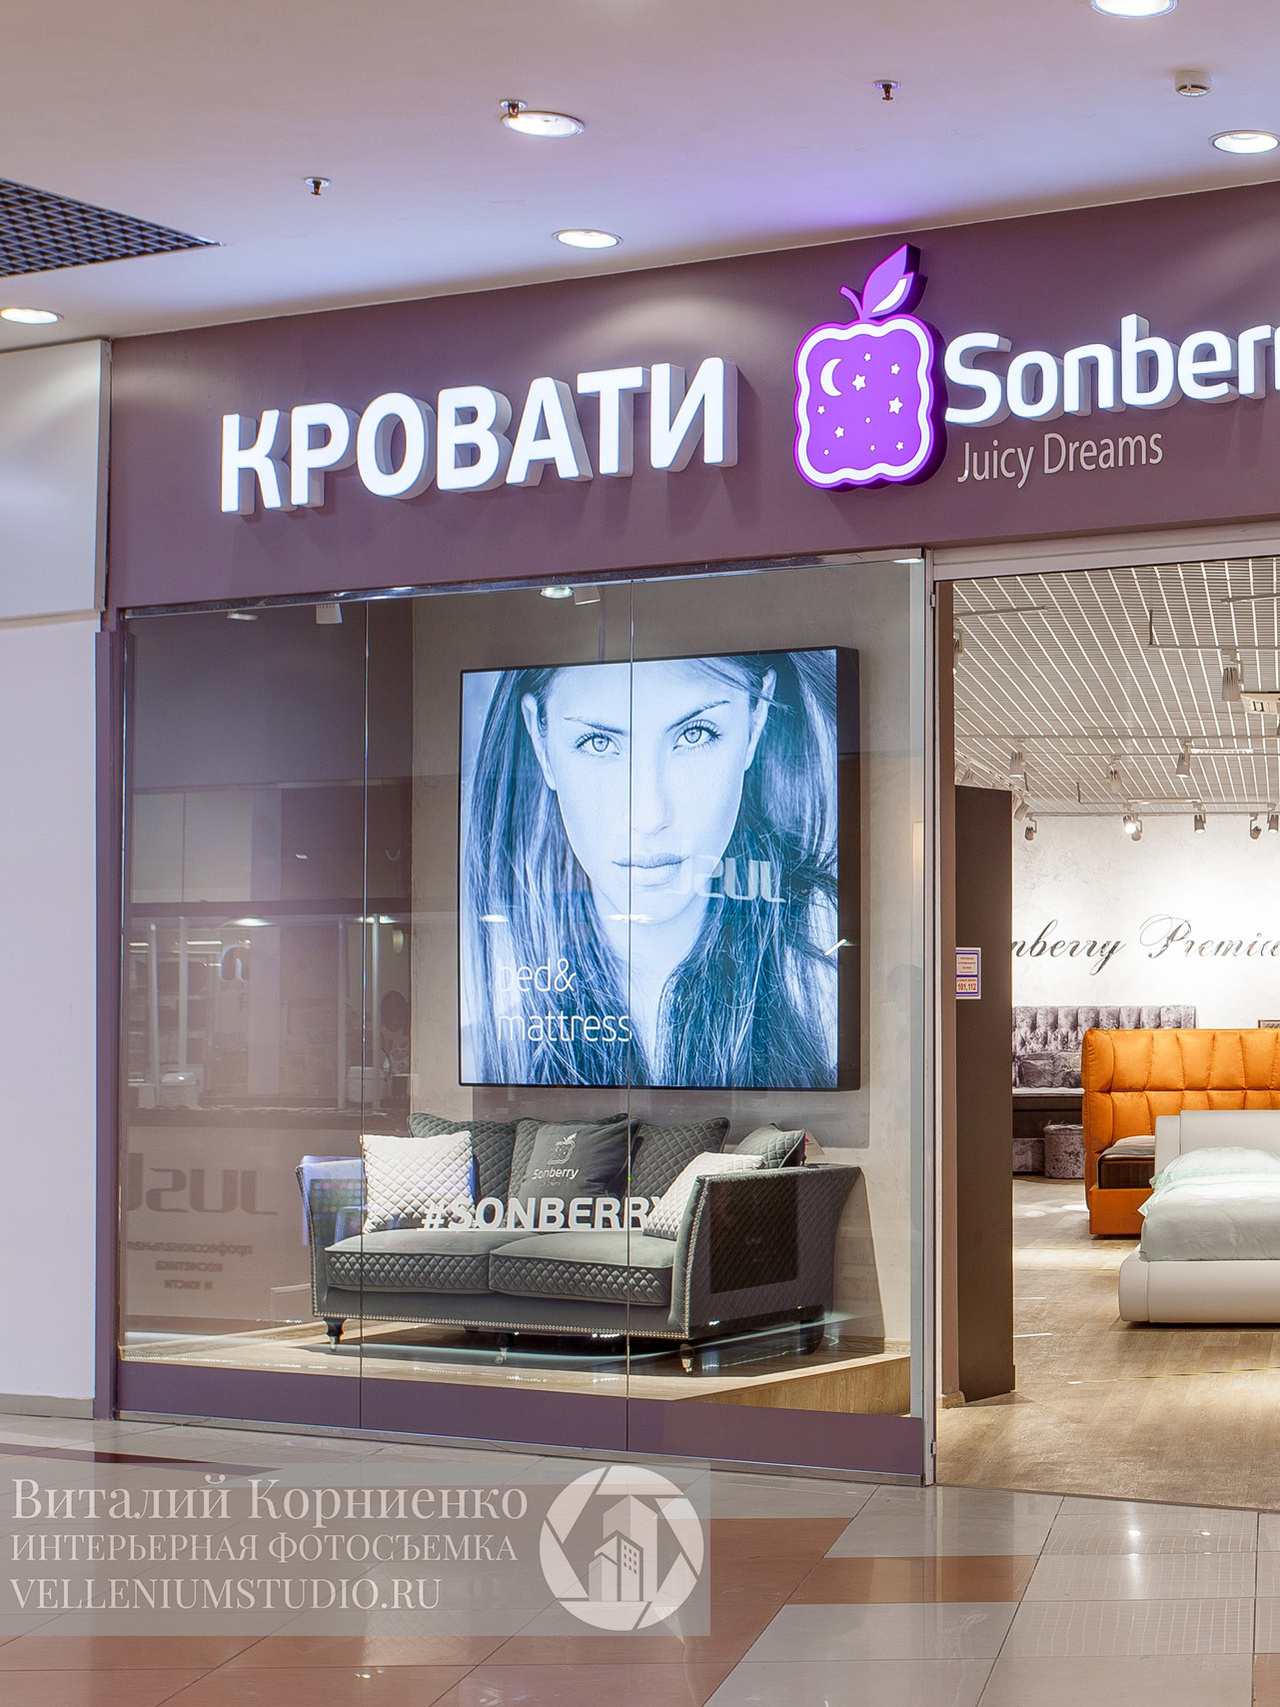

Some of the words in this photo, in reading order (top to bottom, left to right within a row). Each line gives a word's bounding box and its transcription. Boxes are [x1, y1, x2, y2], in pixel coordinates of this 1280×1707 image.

[221, 357, 738, 515] КРОВАТИ
[957, 441, 1035, 489] Juicy
[1043, 431, 1163, 475] Dreams
[1011, 918, 1127, 976] nberry
[498, 957, 577, 992] bed&
[498, 1011, 632, 1042] mattress
[531, 1166, 579, 1181] Sonberry
